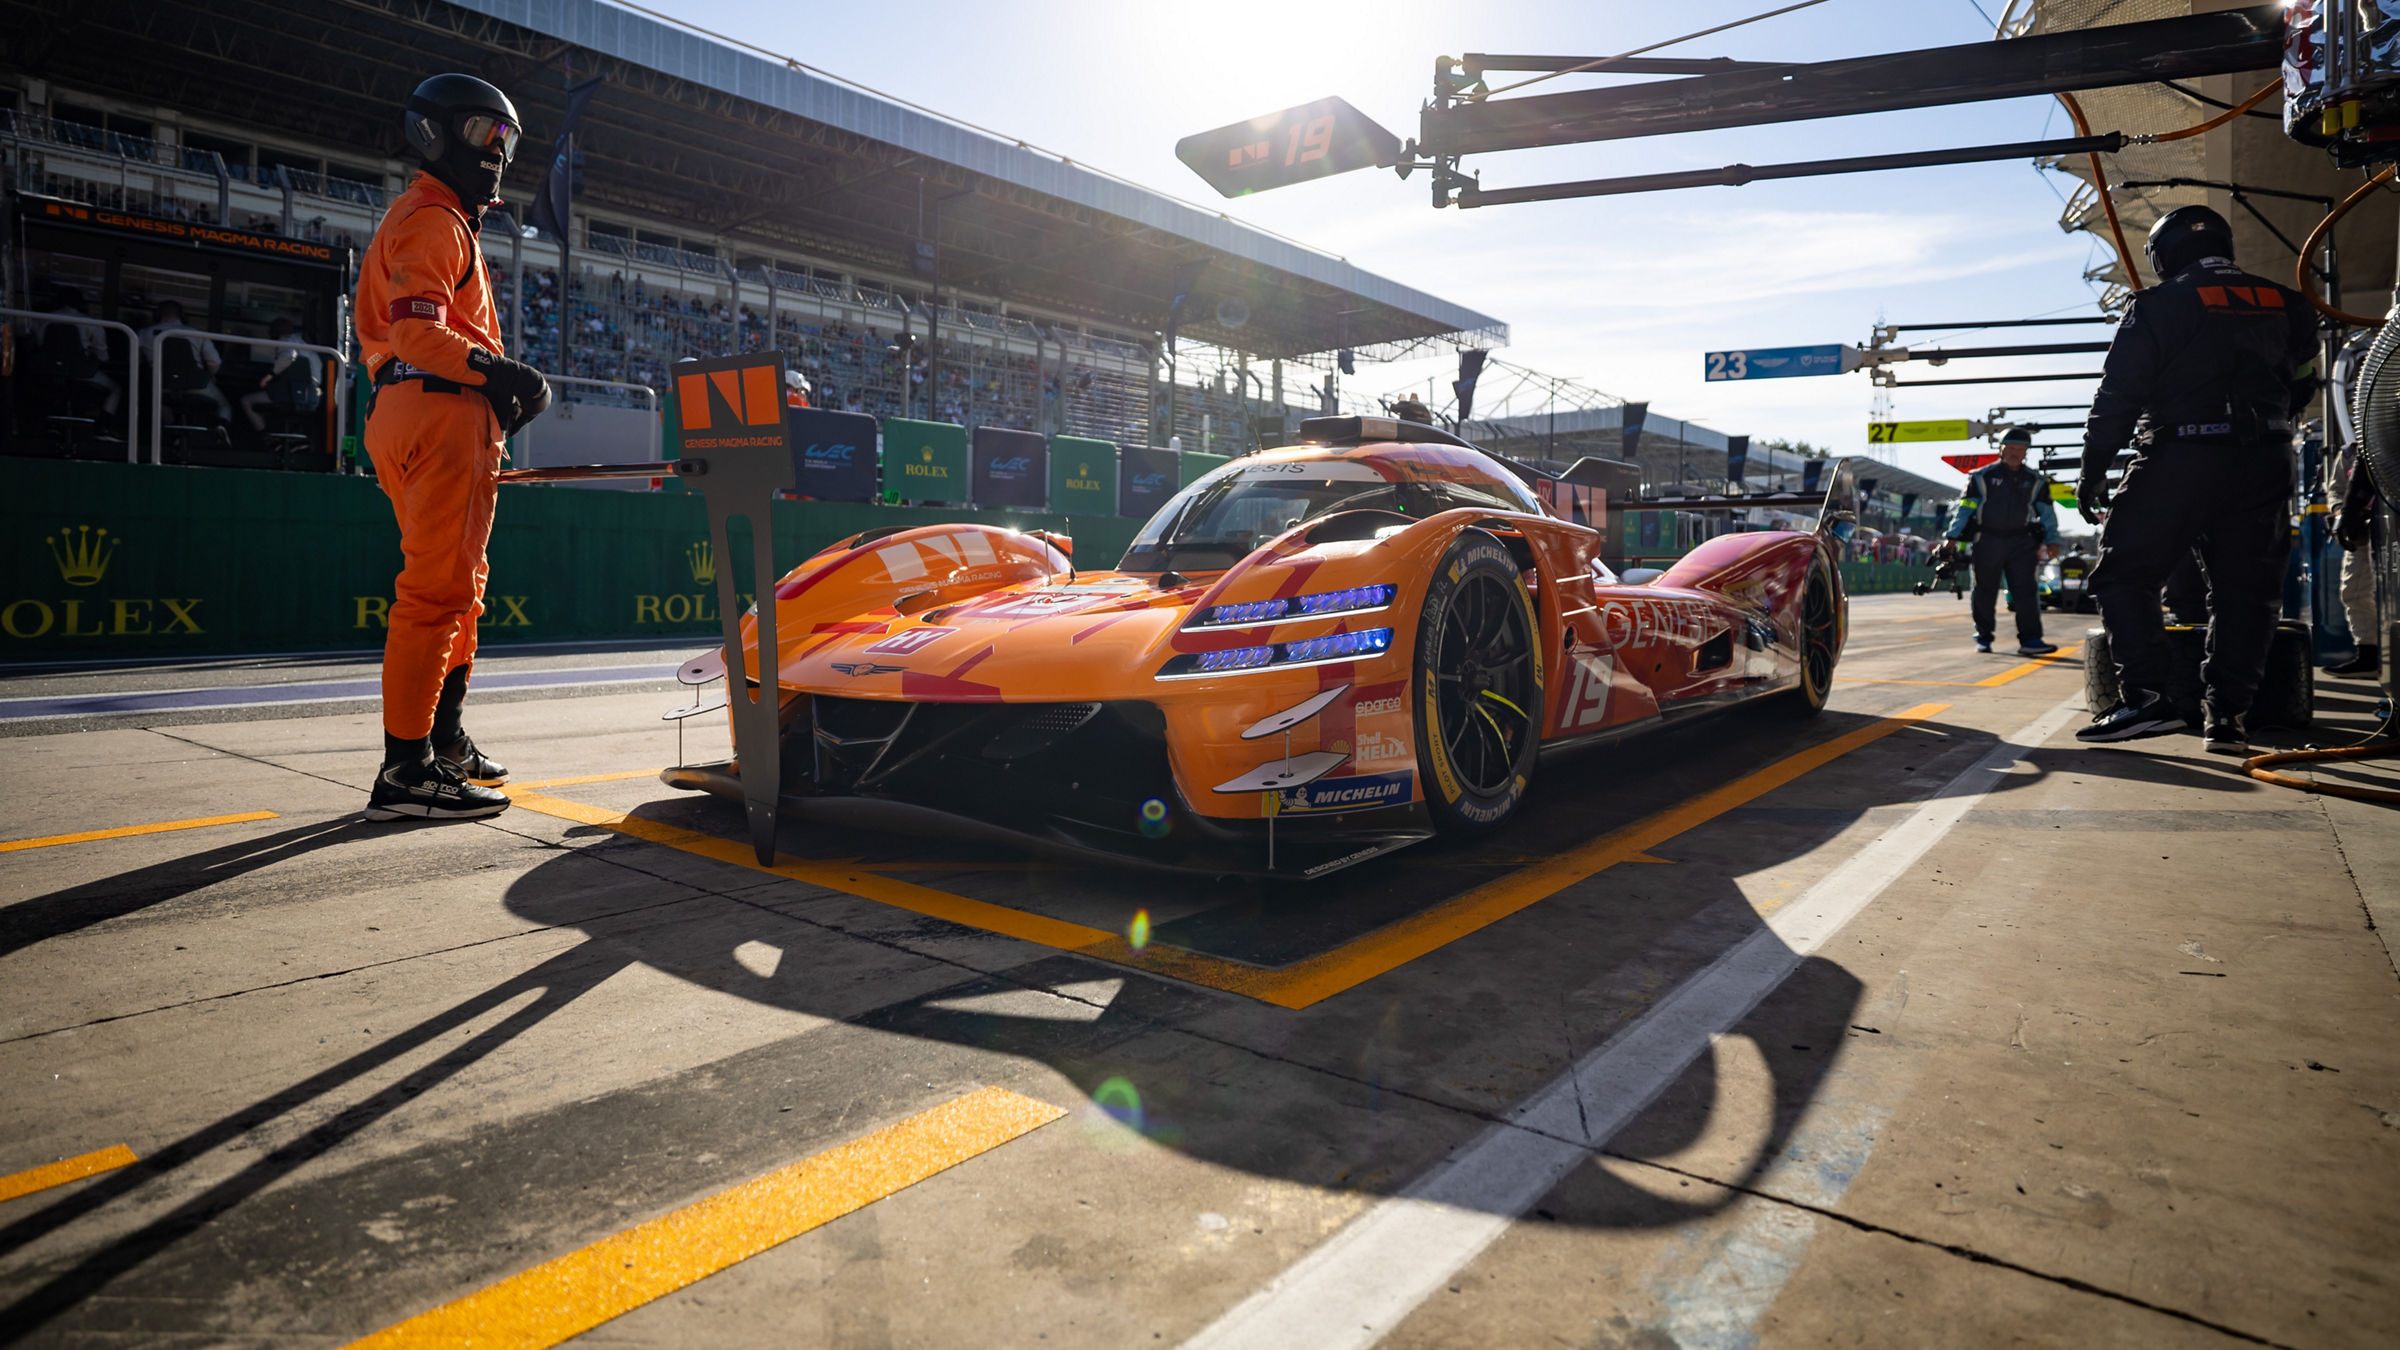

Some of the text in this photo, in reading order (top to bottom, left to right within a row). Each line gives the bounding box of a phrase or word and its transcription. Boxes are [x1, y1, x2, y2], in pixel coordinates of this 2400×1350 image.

[1284, 114, 1335, 167] 19
[96, 212, 330, 259] GENESIS MAGMA RACING
[1708, 351, 1747, 380] 23
[685, 435, 783, 449] GENESIS MAGMA RACING
[1870, 423, 1898, 442] 27
[805, 444, 856, 460] WEC
[905, 463, 948, 479] ROLEX
[990, 456, 1031, 471] WEC
[1066, 478, 1100, 491] ROLEX
[1132, 473, 1167, 487] WEC
[1467, 545, 1516, 573] MICHELIN
[971, 571, 1002, 583] RACING
[876, 630, 946, 649] HY
[1561, 655, 1613, 729] 19
[1356, 697, 1401, 717] sparco
[1357, 731, 1381, 745] Shell
[1357, 738, 1408, 761] HELIX
[1432, 733, 1445, 768] SPORT
[1314, 782, 1401, 804] MICHELIN
[1460, 790, 1512, 822] MICHELIN
[1304, 859, 1341, 875] DESIGNED
